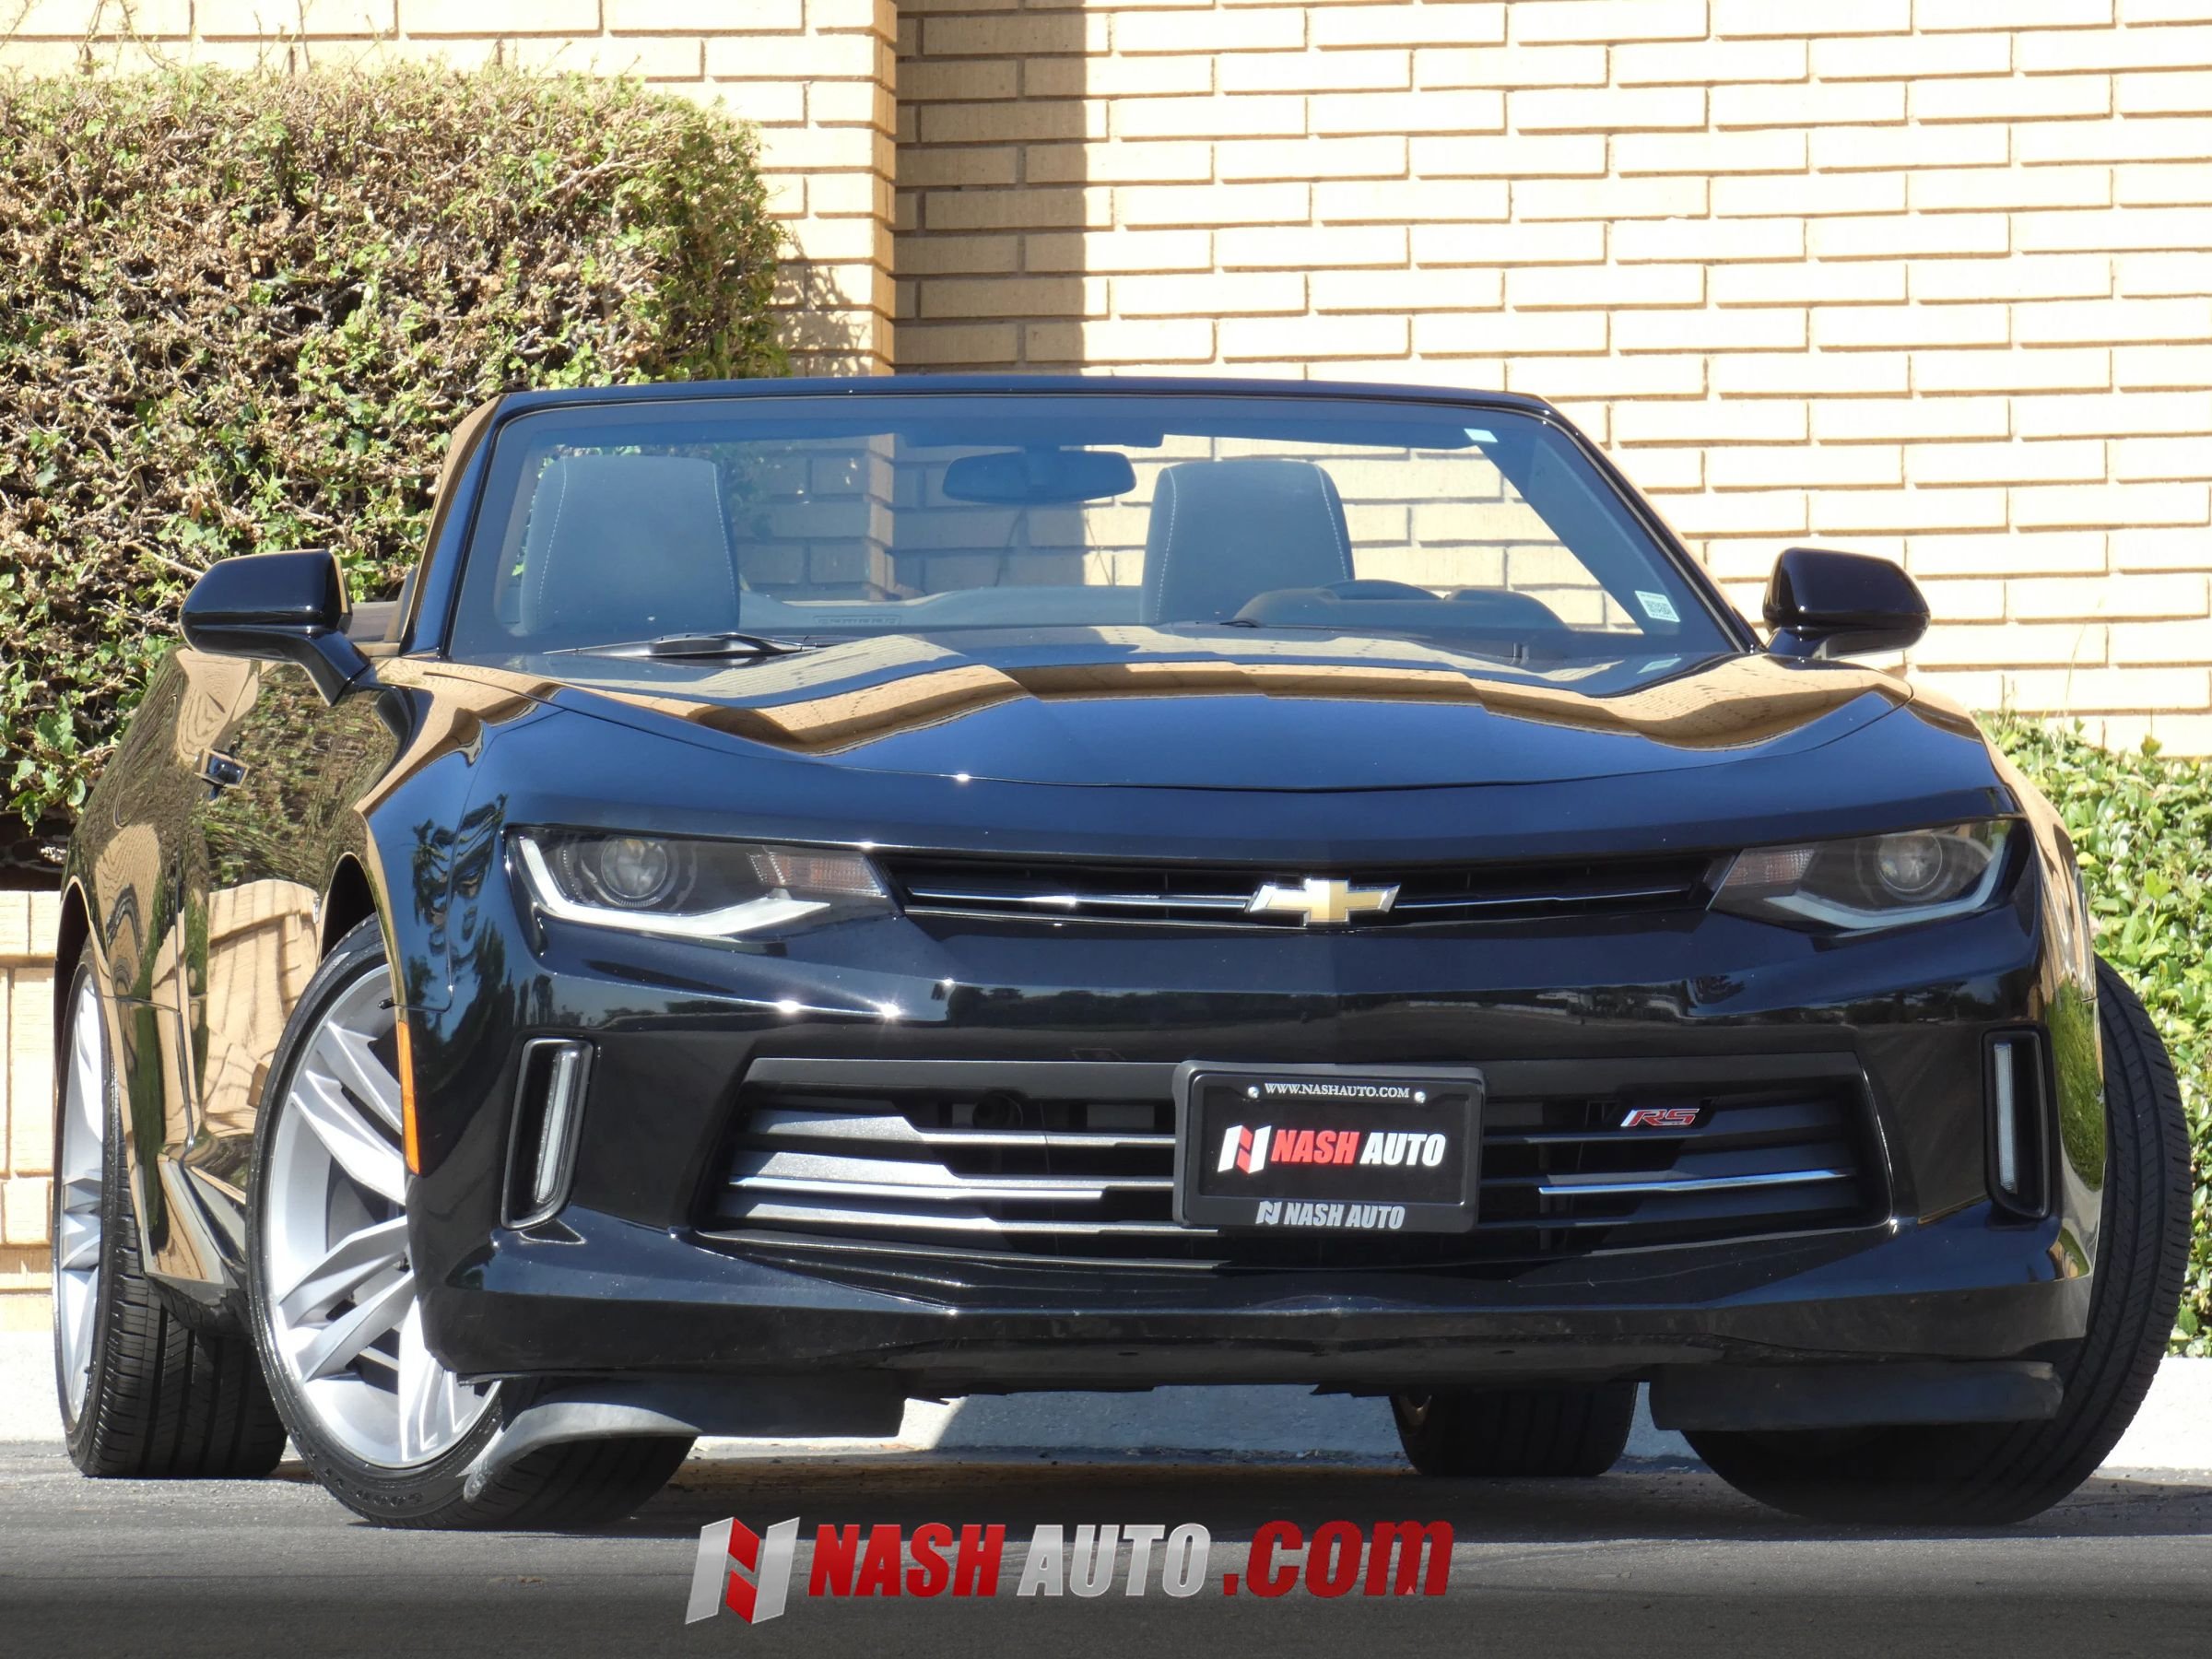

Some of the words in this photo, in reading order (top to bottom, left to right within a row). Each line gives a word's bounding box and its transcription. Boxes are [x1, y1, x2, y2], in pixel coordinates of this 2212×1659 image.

[1265, 1083, 1409, 1098] WWW.NASHAUTO.COM
[1620, 1108, 1700, 1127] RS
[1270, 1129, 1359, 1165] NASH
[1359, 1132, 1446, 1167] AUTO
[1283, 1201, 1345, 1227] NASH
[1345, 1205, 1405, 1230] AUTO
